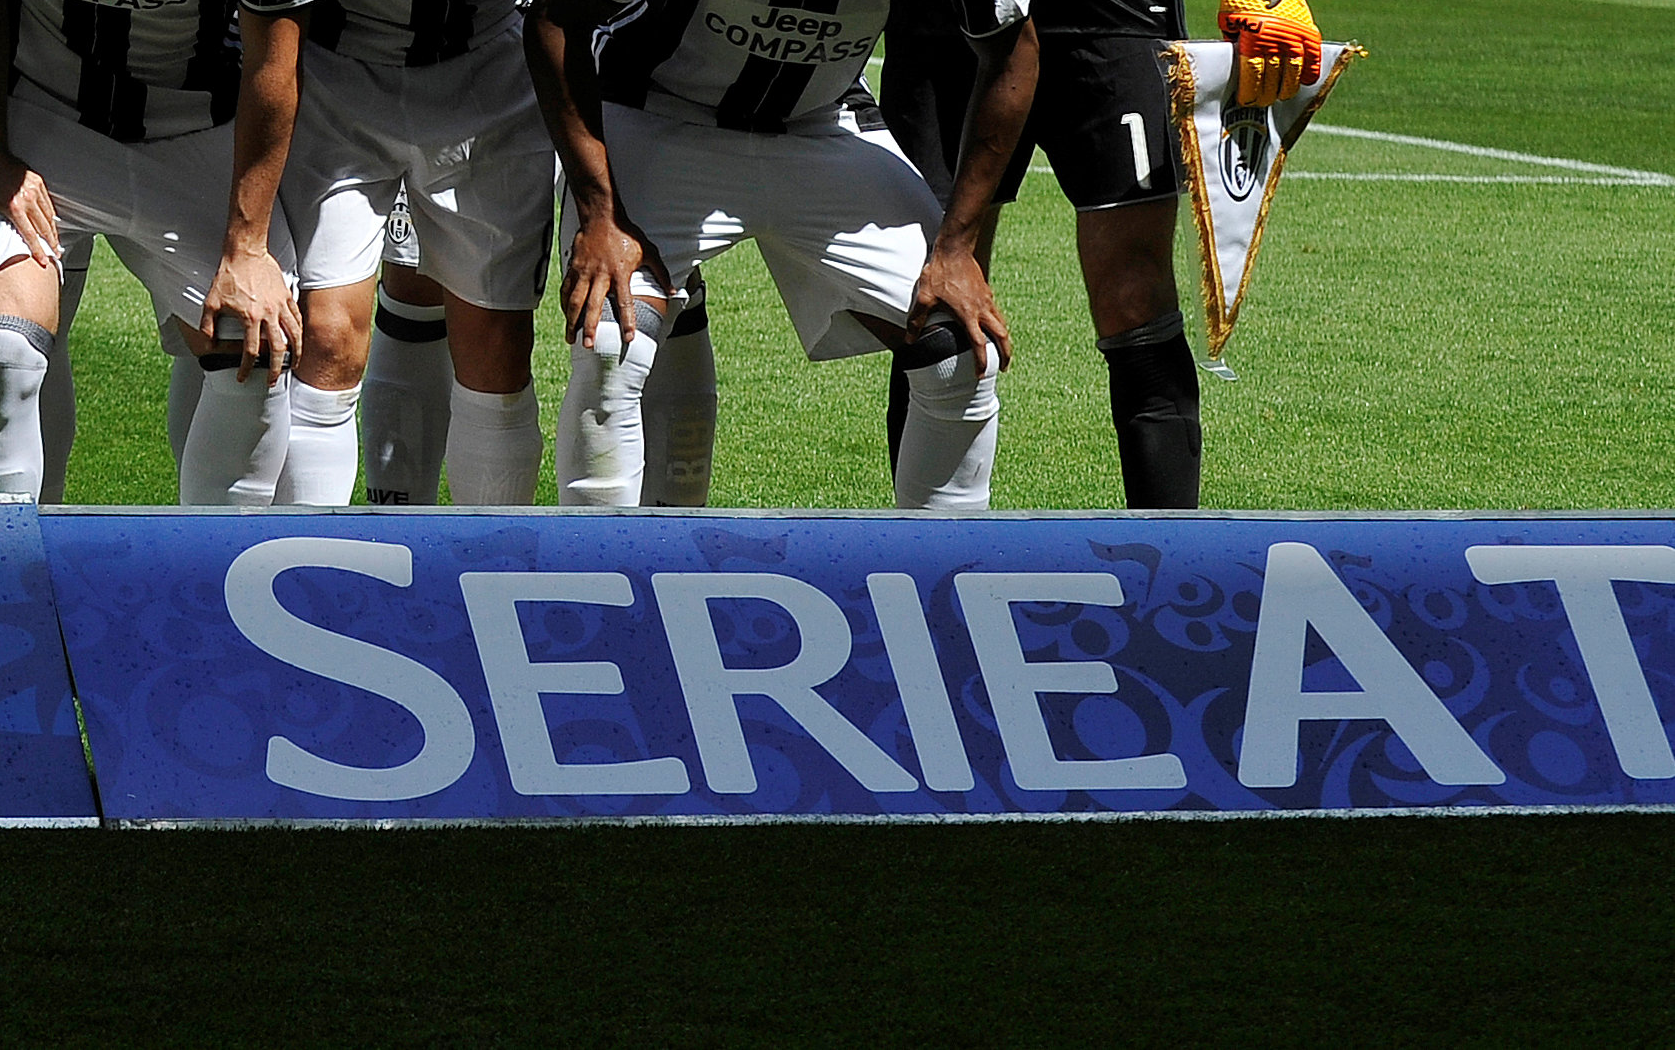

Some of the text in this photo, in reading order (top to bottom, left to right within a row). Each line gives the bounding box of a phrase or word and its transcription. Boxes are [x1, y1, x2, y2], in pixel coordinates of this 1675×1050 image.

[705, 12, 873, 63] COMPASS
[751, 8, 843, 41] Jeep
[1120, 112, 1153, 190] 1
[367, 487, 409, 505] UVE
[222, 535, 1188, 802] SERIE
[1237, 541, 1508, 789] A
